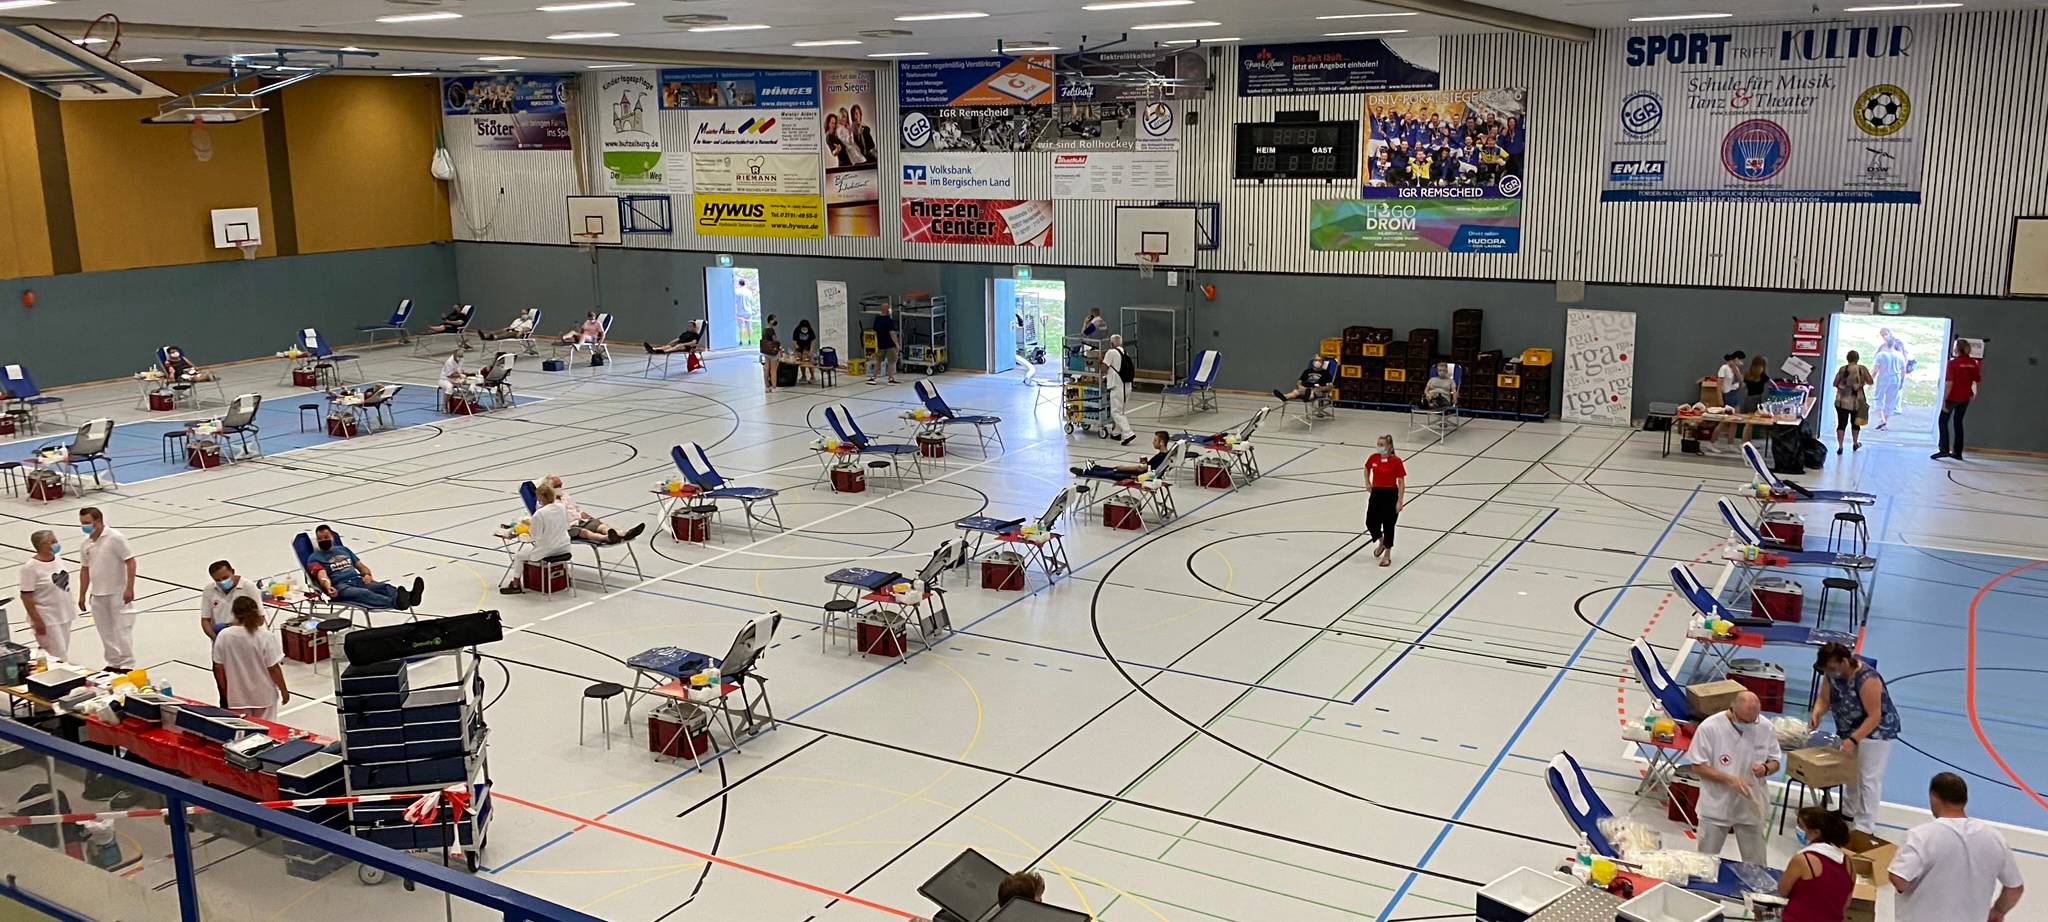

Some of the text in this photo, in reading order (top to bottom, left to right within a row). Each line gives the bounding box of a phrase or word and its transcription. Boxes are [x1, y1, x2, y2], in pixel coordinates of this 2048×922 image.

[1626, 25, 1914, 66] SPORT TRIFFT KULTUR
[933, 62, 964, 70] regelmäßig
[966, 60, 1000, 68] Verstärkung
[1347, 60, 1378, 68] einholen!
[603, 76, 654, 90] Kindertagespflege
[844, 82, 870, 93] Sieger!
[1688, 74, 1836, 94] Schule für Musik,
[1688, 88, 1819, 109] Tanz & Theater
[940, 108, 1008, 117] IGR Remscheid
[478, 120, 514, 136] Stöter
[1038, 140, 1051, 148] wir
[1056, 139, 1076, 149] sind
[1079, 139, 1134, 150] Rollhockey
[930, 166, 972, 174] Volksbank
[1612, 160, 1662, 175] EMKA
[930, 177, 1010, 189] im Bergischen Land
[1398, 188, 1483, 197] IGR REMSCHEID
[931, 218, 996, 236] Center
[1366, 218, 1416, 230] DROM
[1570, 346, 1627, 376] rga.
[1566, 387, 1618, 415] rga.
